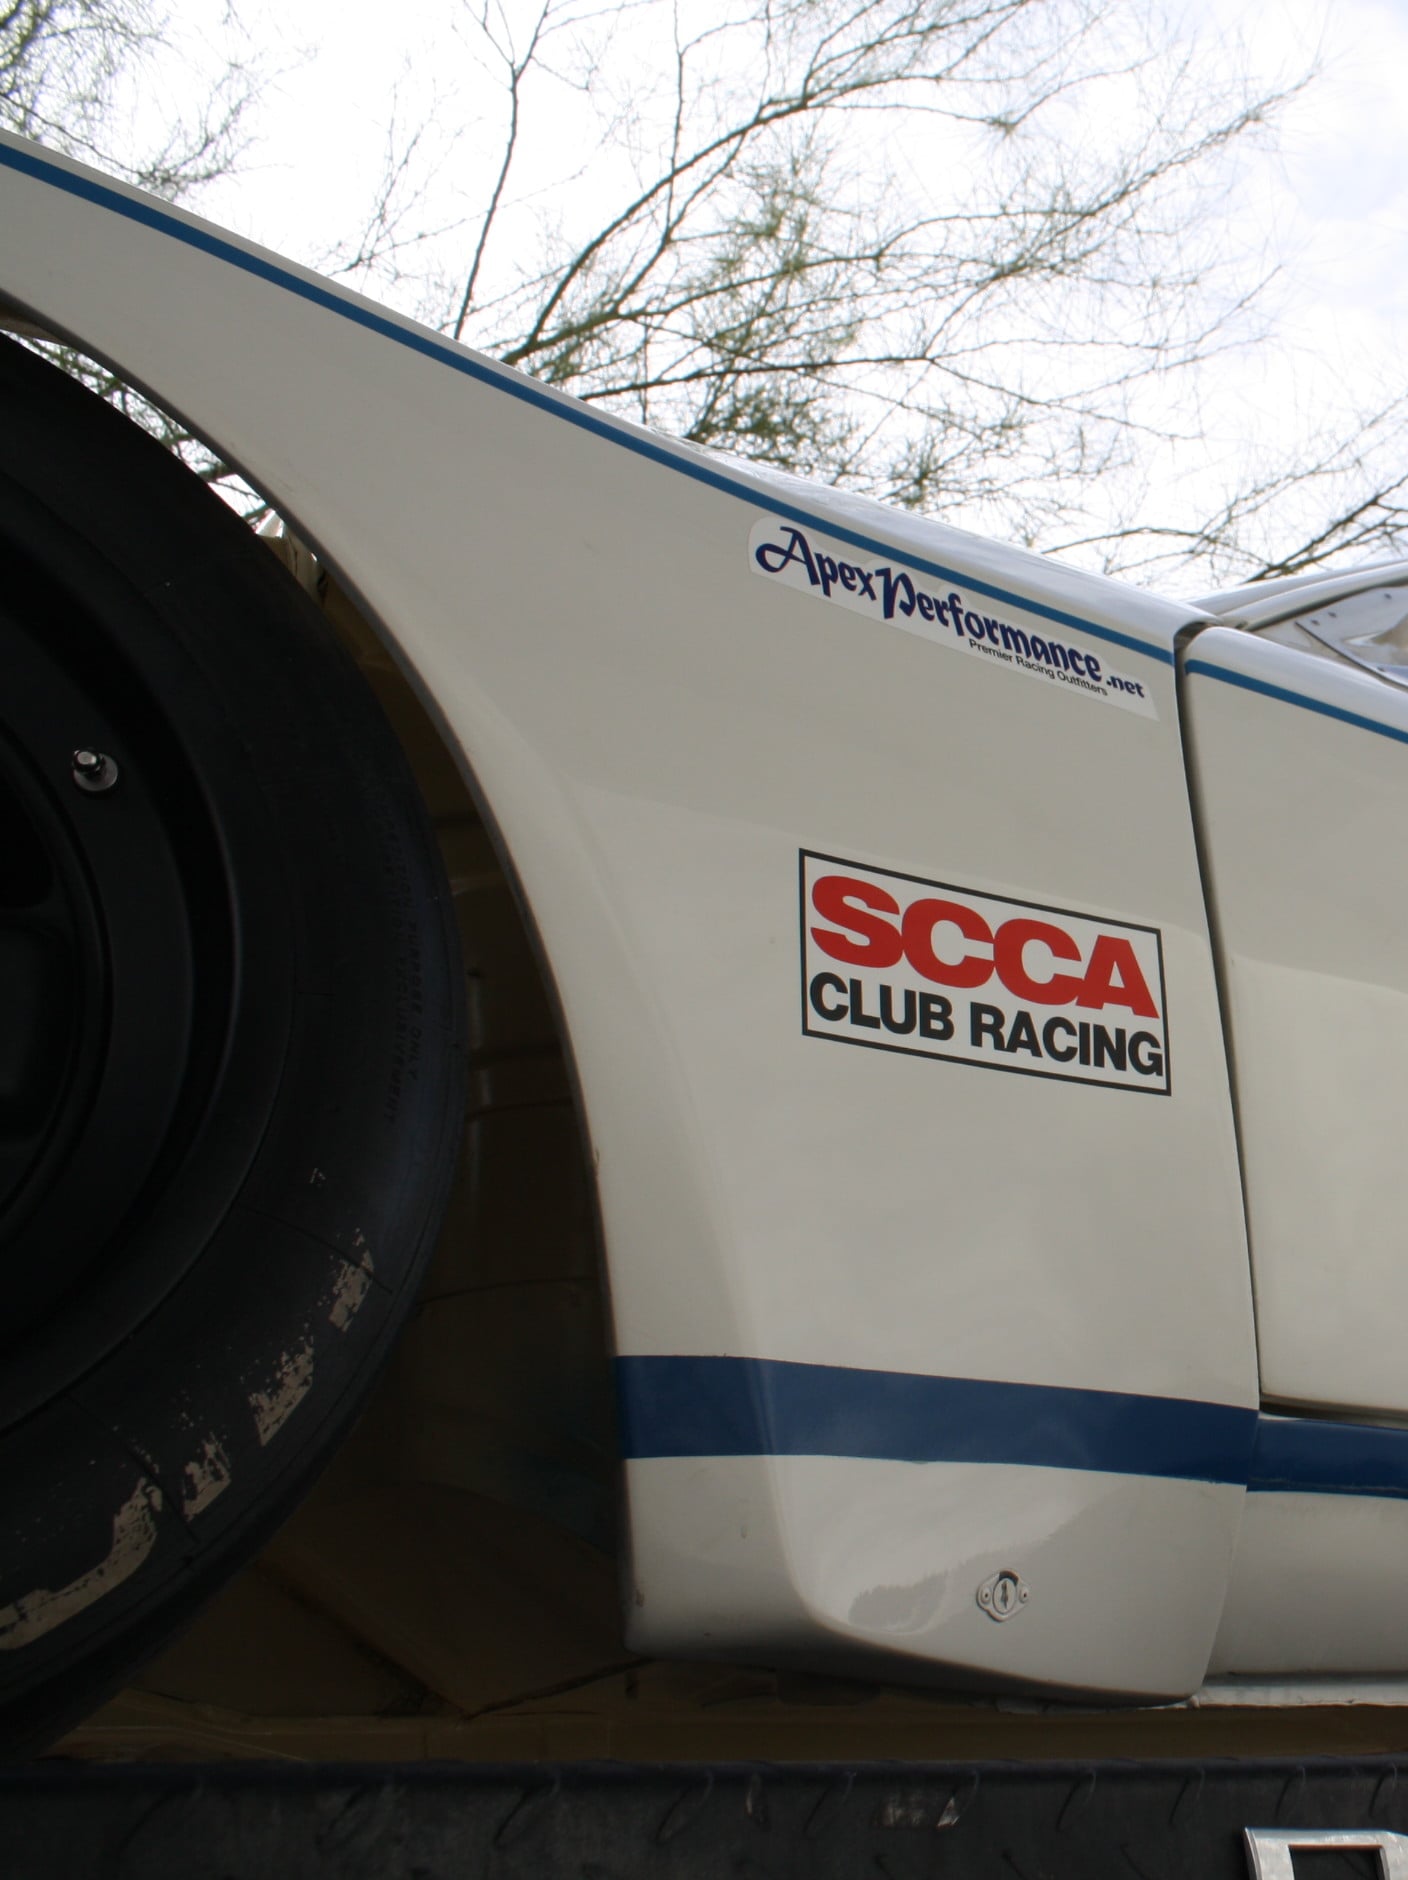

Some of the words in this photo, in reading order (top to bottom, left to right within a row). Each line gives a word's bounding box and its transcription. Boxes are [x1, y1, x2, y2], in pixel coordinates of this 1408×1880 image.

[969, 638, 1013, 663] Premier
[1015, 654, 1055, 680] Racing
[1056, 669, 1108, 697] Outfitters
[810, 875, 1160, 1019] SCCA
[809, 972, 955, 1041] CLUB
[970, 1001, 1164, 1077] RACING
